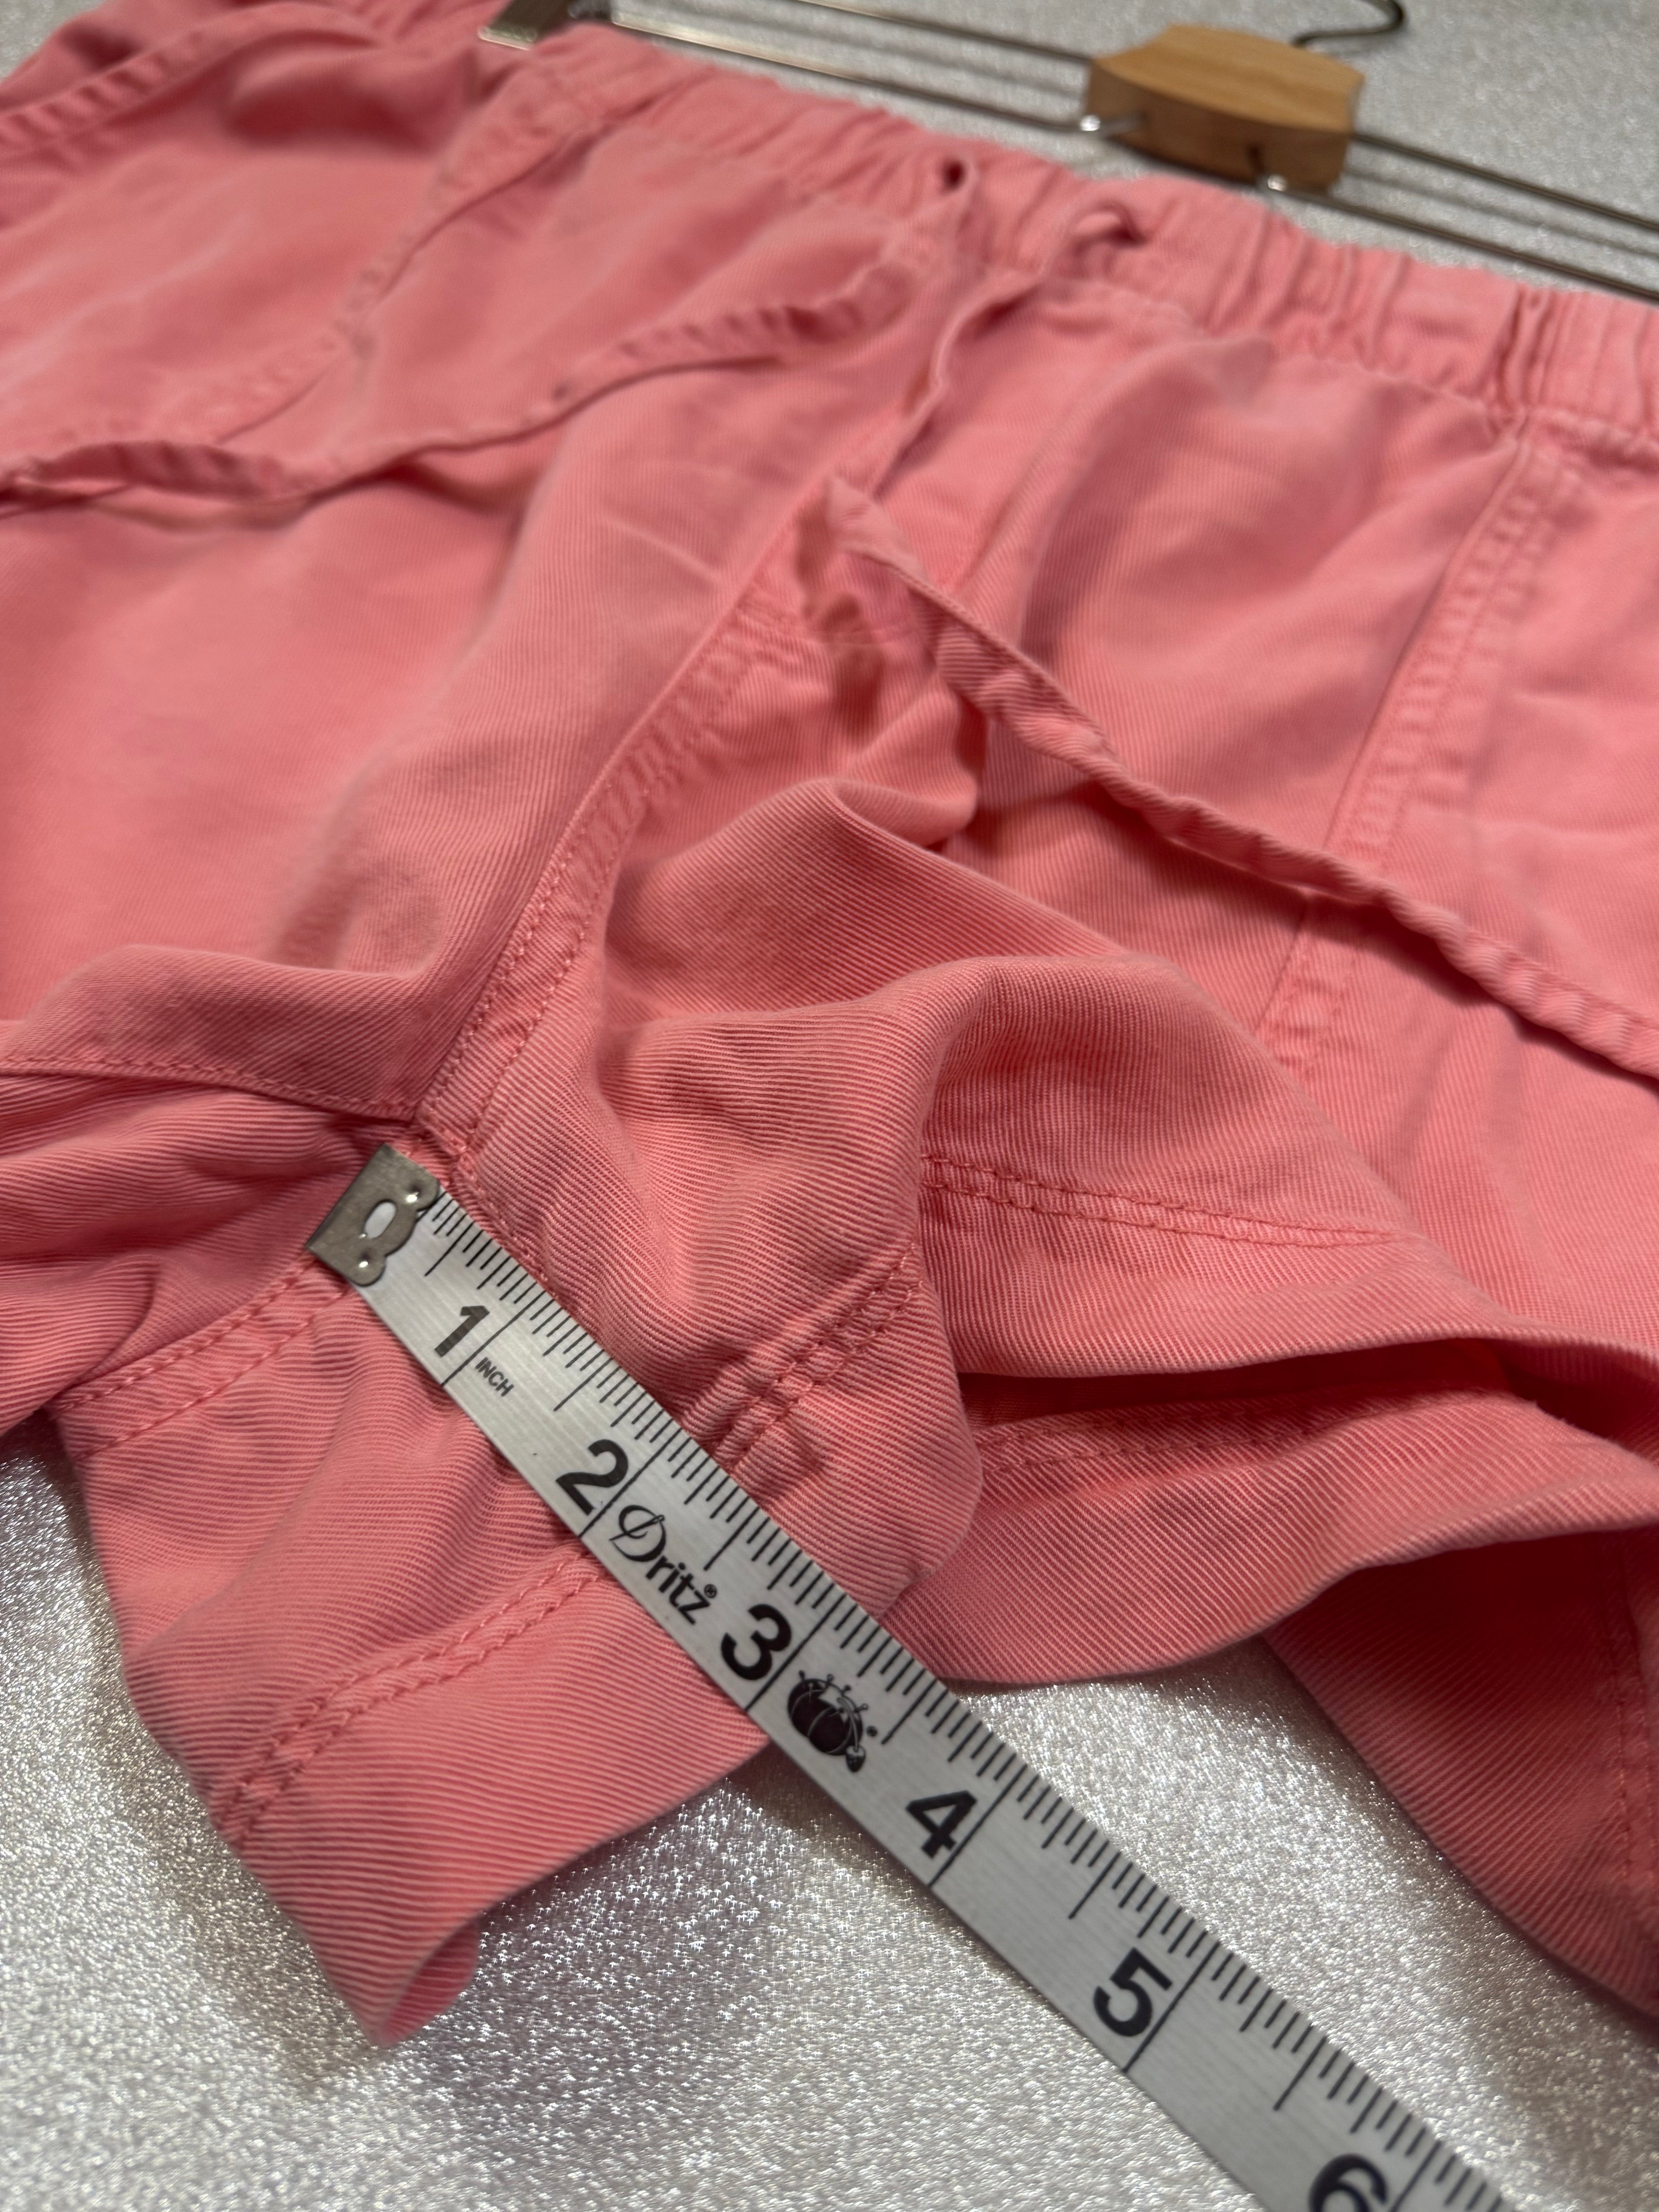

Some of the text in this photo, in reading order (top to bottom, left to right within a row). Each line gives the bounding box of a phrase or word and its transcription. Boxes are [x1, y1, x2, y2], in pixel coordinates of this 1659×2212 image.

[434, 1305, 489, 1357] 1
[476, 1357, 514, 1397] INCH
[556, 1439, 629, 1514] 2
[721, 1604, 792, 1680] 3
[907, 1790, 976, 1858] 4
[1093, 1948, 1172, 2036] 5
